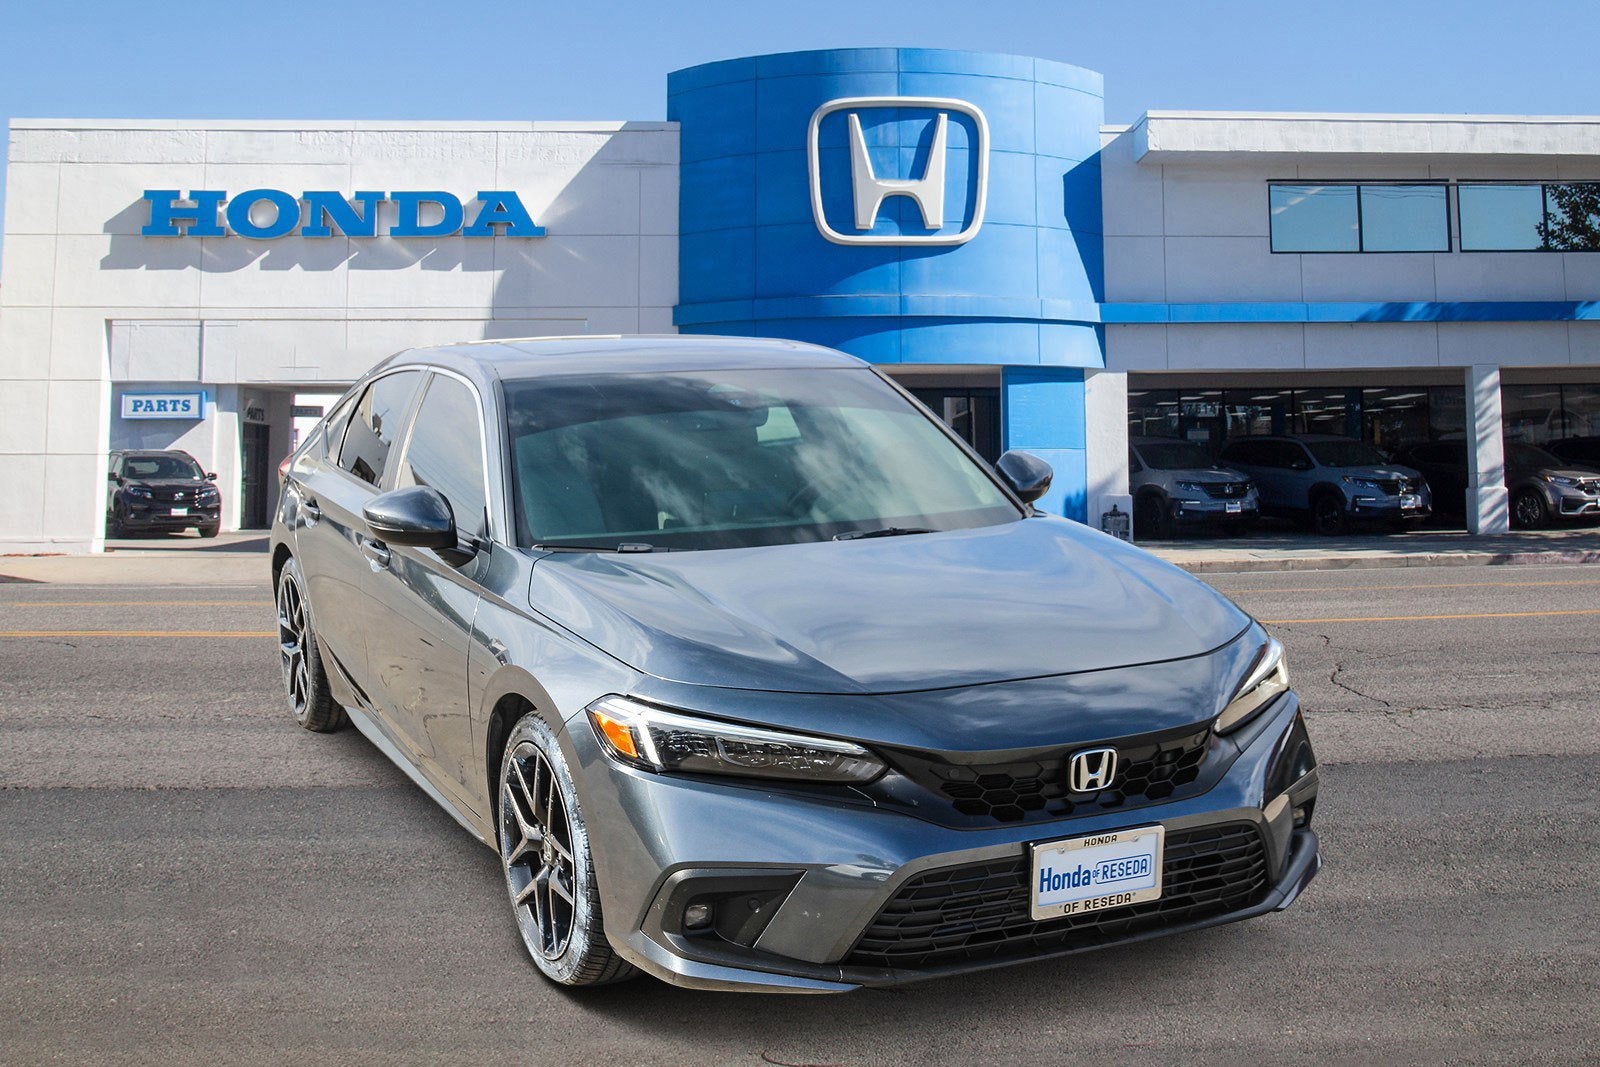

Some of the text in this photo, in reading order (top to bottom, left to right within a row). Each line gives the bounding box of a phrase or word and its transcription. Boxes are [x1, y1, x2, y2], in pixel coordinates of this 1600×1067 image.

[141, 188, 548, 239] HONDA
[131, 399, 191, 412] PARTS
[1083, 834, 1118, 847] HONDA
[1039, 858, 1148, 893] Honda OF RESEDA
[1063, 893, 1131, 914] OF RESEDA
